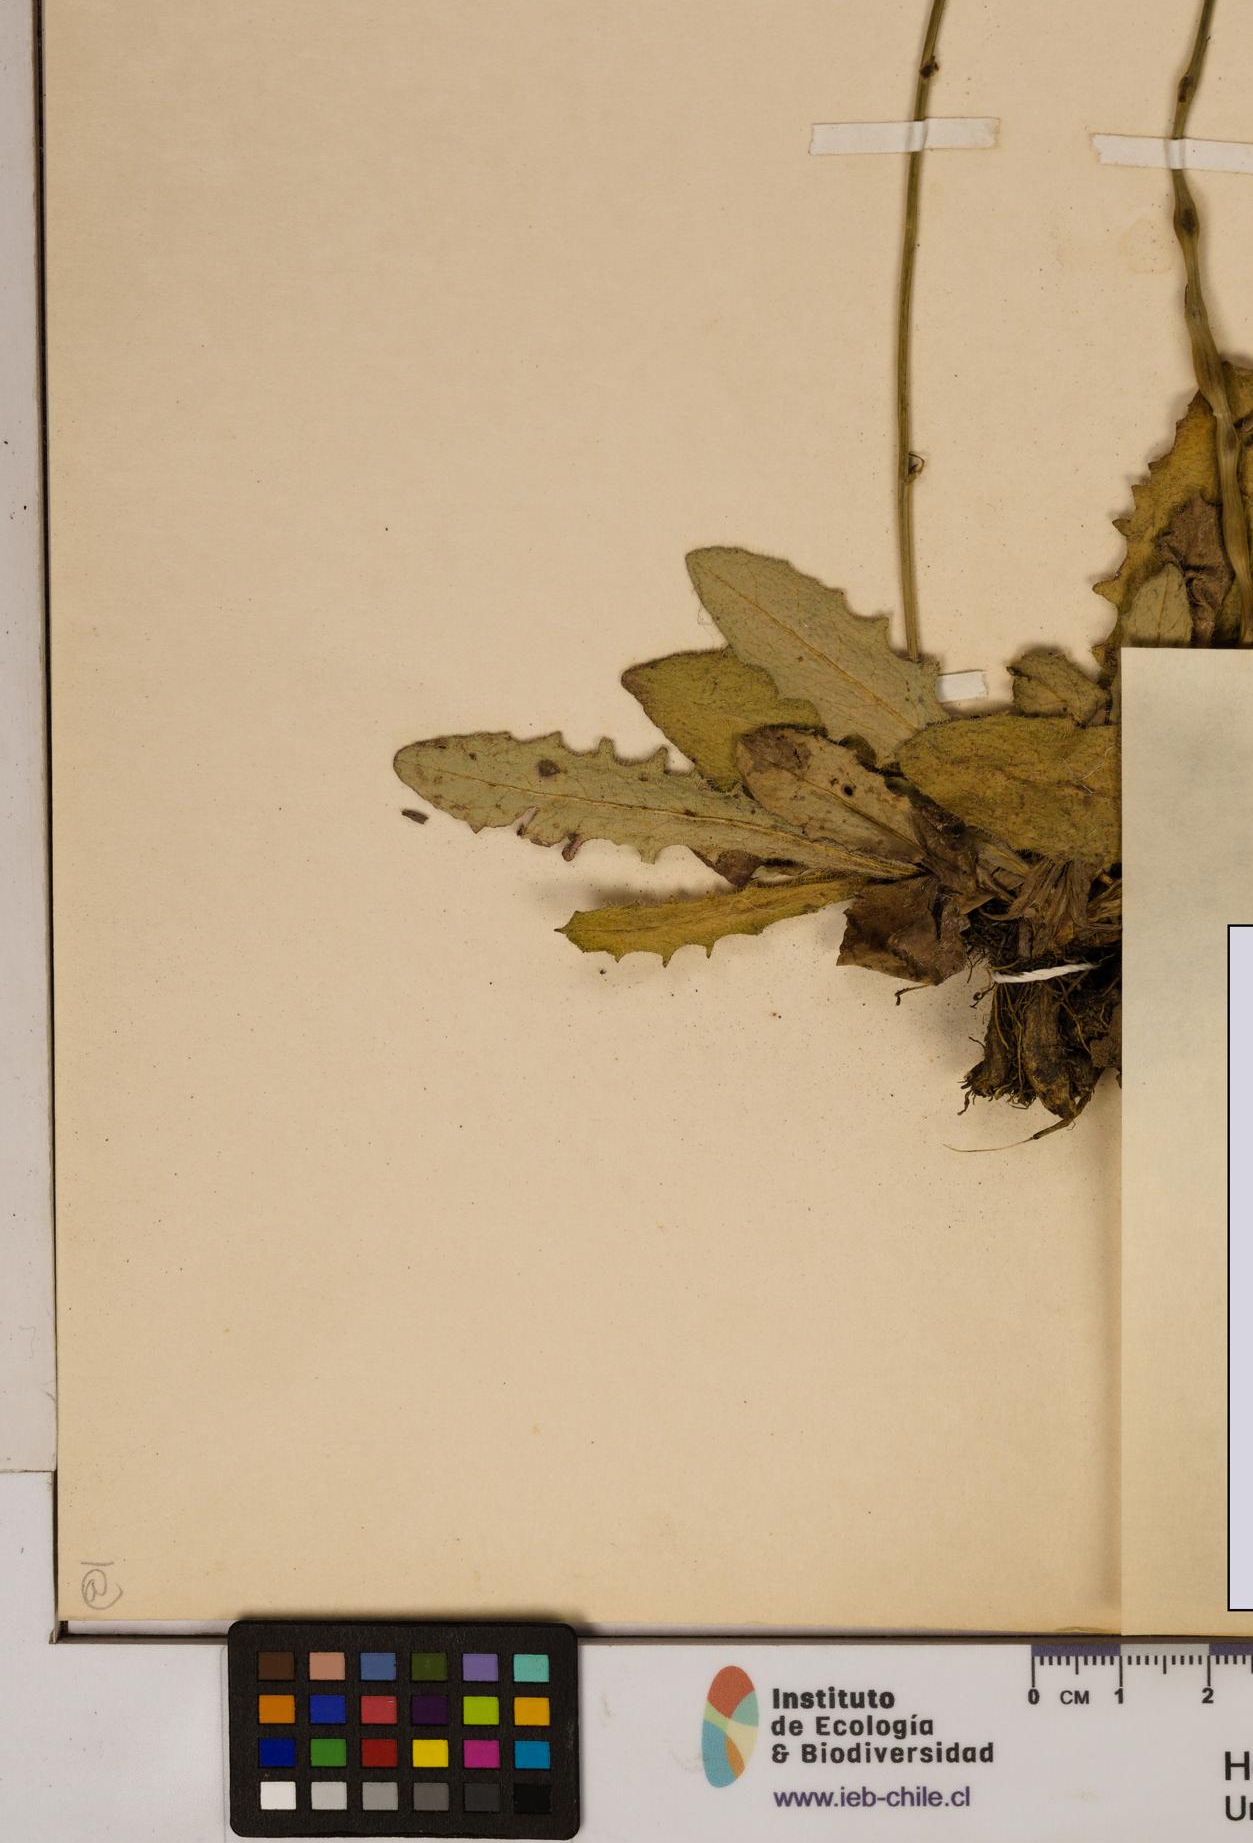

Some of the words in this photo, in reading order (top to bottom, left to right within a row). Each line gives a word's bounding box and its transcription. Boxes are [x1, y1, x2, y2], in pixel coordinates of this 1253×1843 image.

[772, 1685, 896, 1710] Instituto
[1027, 1687, 1041, 1706] 0
[1059, 1689, 1090, 1706] CM
[1113, 1686, 1124, 1705] 1
[1201, 1686, 1215, 1705] 2
[770, 1714, 804, 1737] de
[815, 1713, 934, 1741] Ecología
[771, 1742, 790, 1764] &
[801, 1741, 994, 1765] Biodiversidad
[773, 1785, 971, 1808] www.ieb-chile.cl
